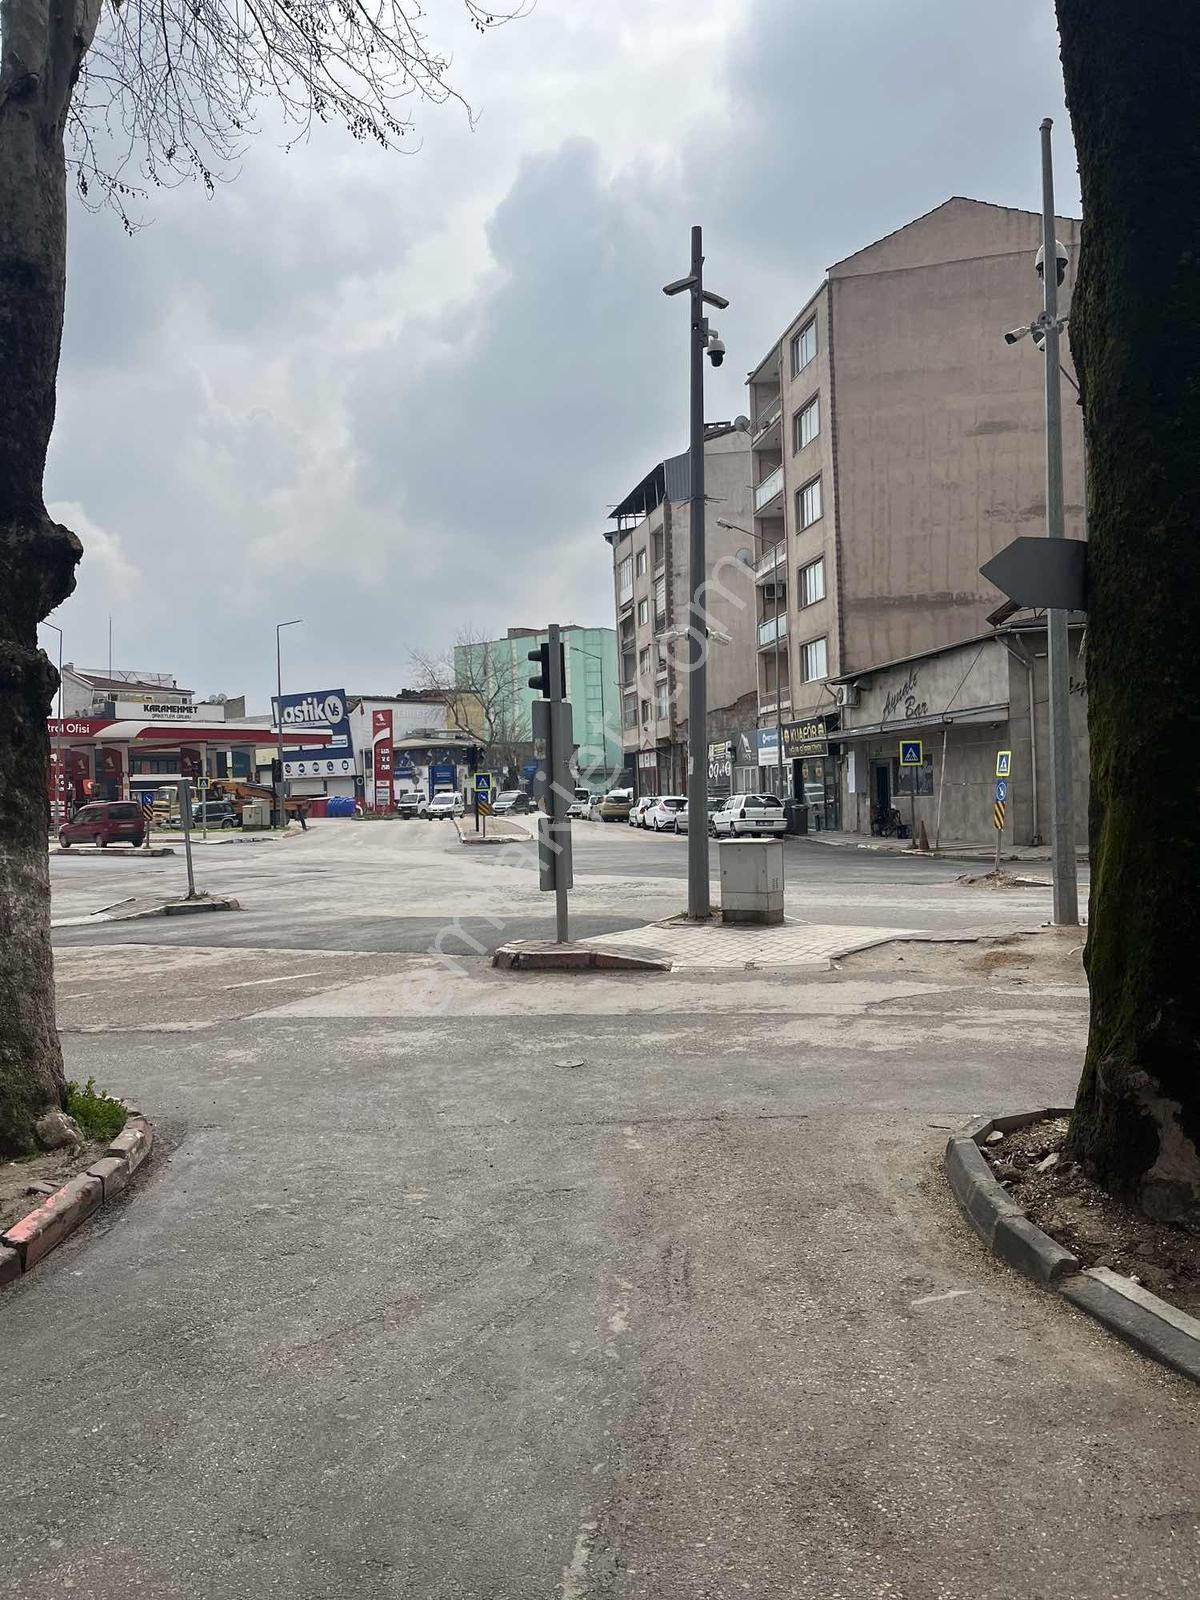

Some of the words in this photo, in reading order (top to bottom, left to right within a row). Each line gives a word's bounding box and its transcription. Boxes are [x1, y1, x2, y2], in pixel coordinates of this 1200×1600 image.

[143, 704, 198, 714] KARAMEHMET
[272, 697, 327, 724] Lastik
[904, 695, 929, 719] Bar
[47, 724, 64, 733] trol
[66, 723, 90, 734] Ofisi
